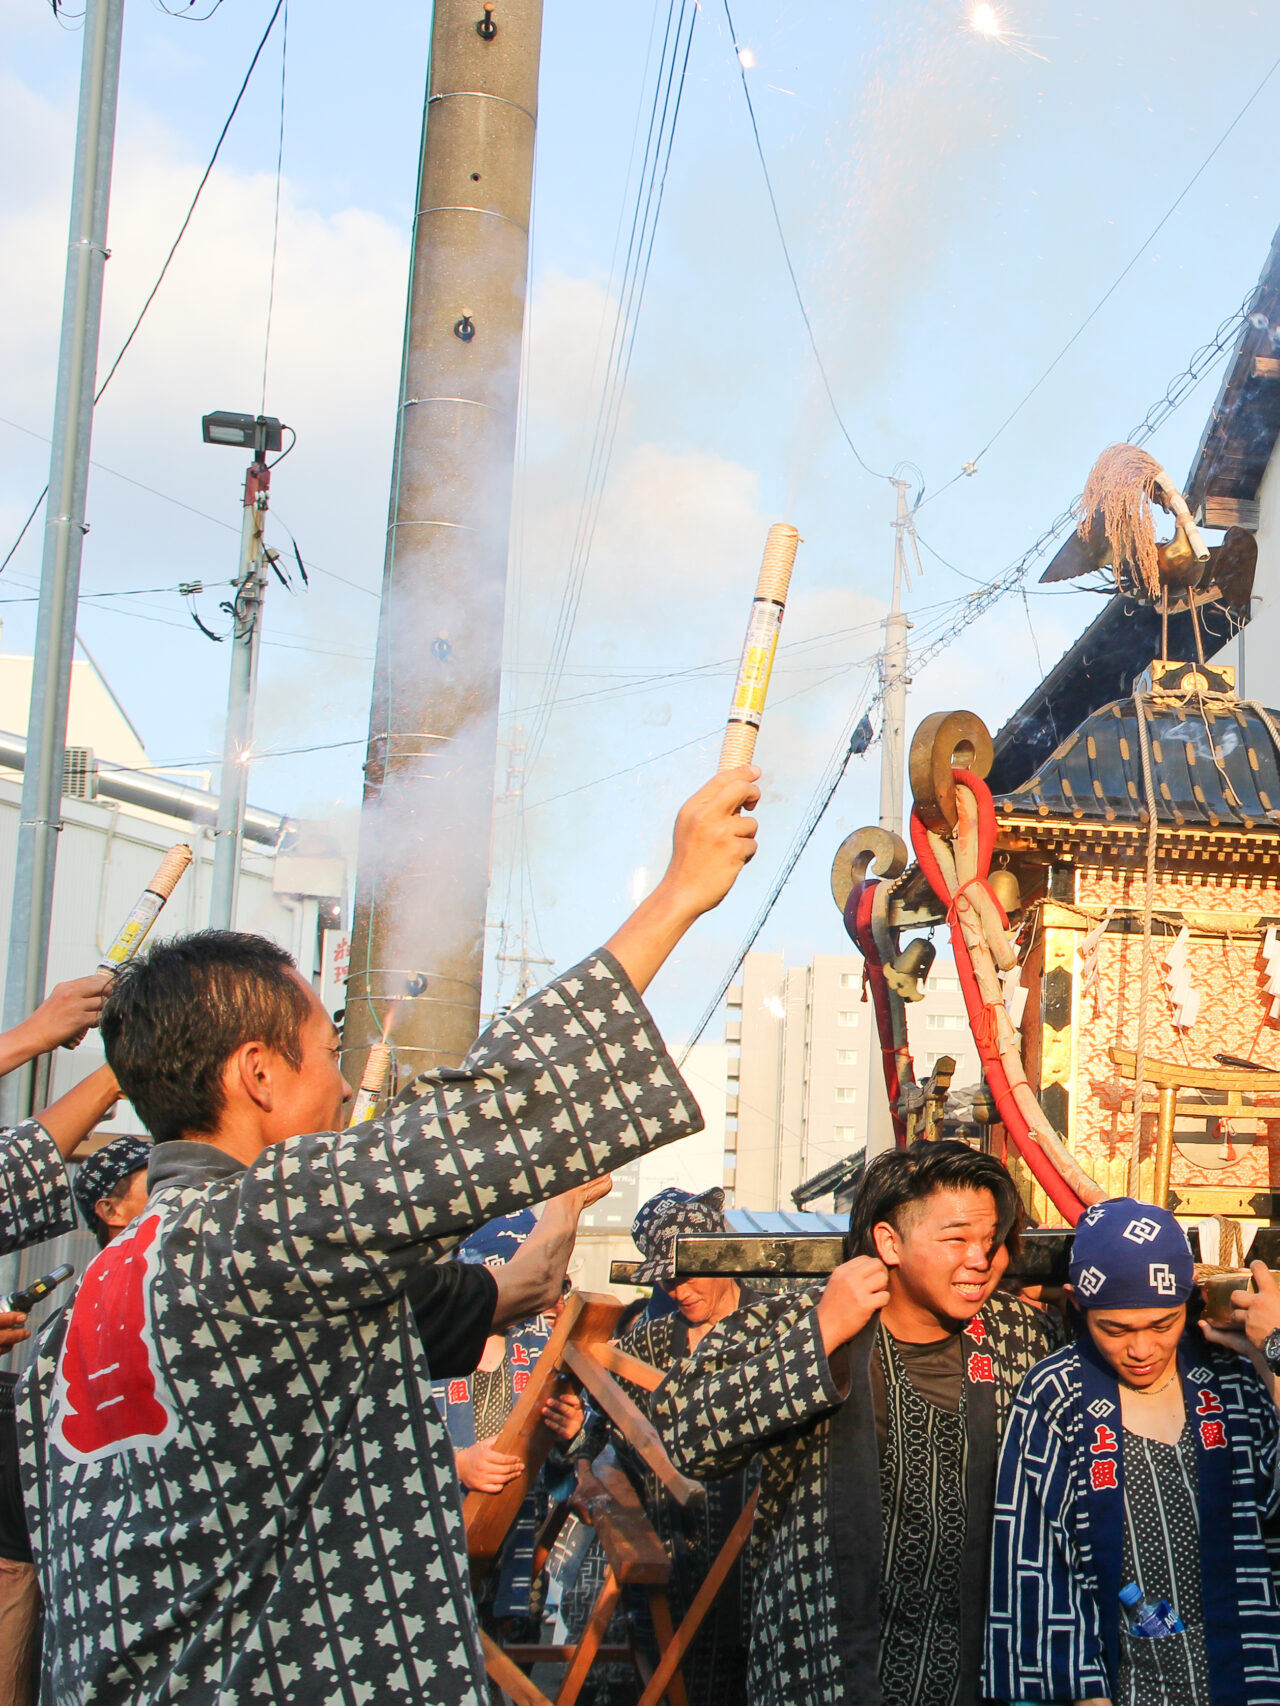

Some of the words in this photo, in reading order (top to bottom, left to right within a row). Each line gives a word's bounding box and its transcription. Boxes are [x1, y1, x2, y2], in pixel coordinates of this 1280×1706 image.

[964, 1313, 995, 1384] 本組
[1196, 1389, 1228, 1450] 上組
[1089, 1424, 1119, 1492] 上組
